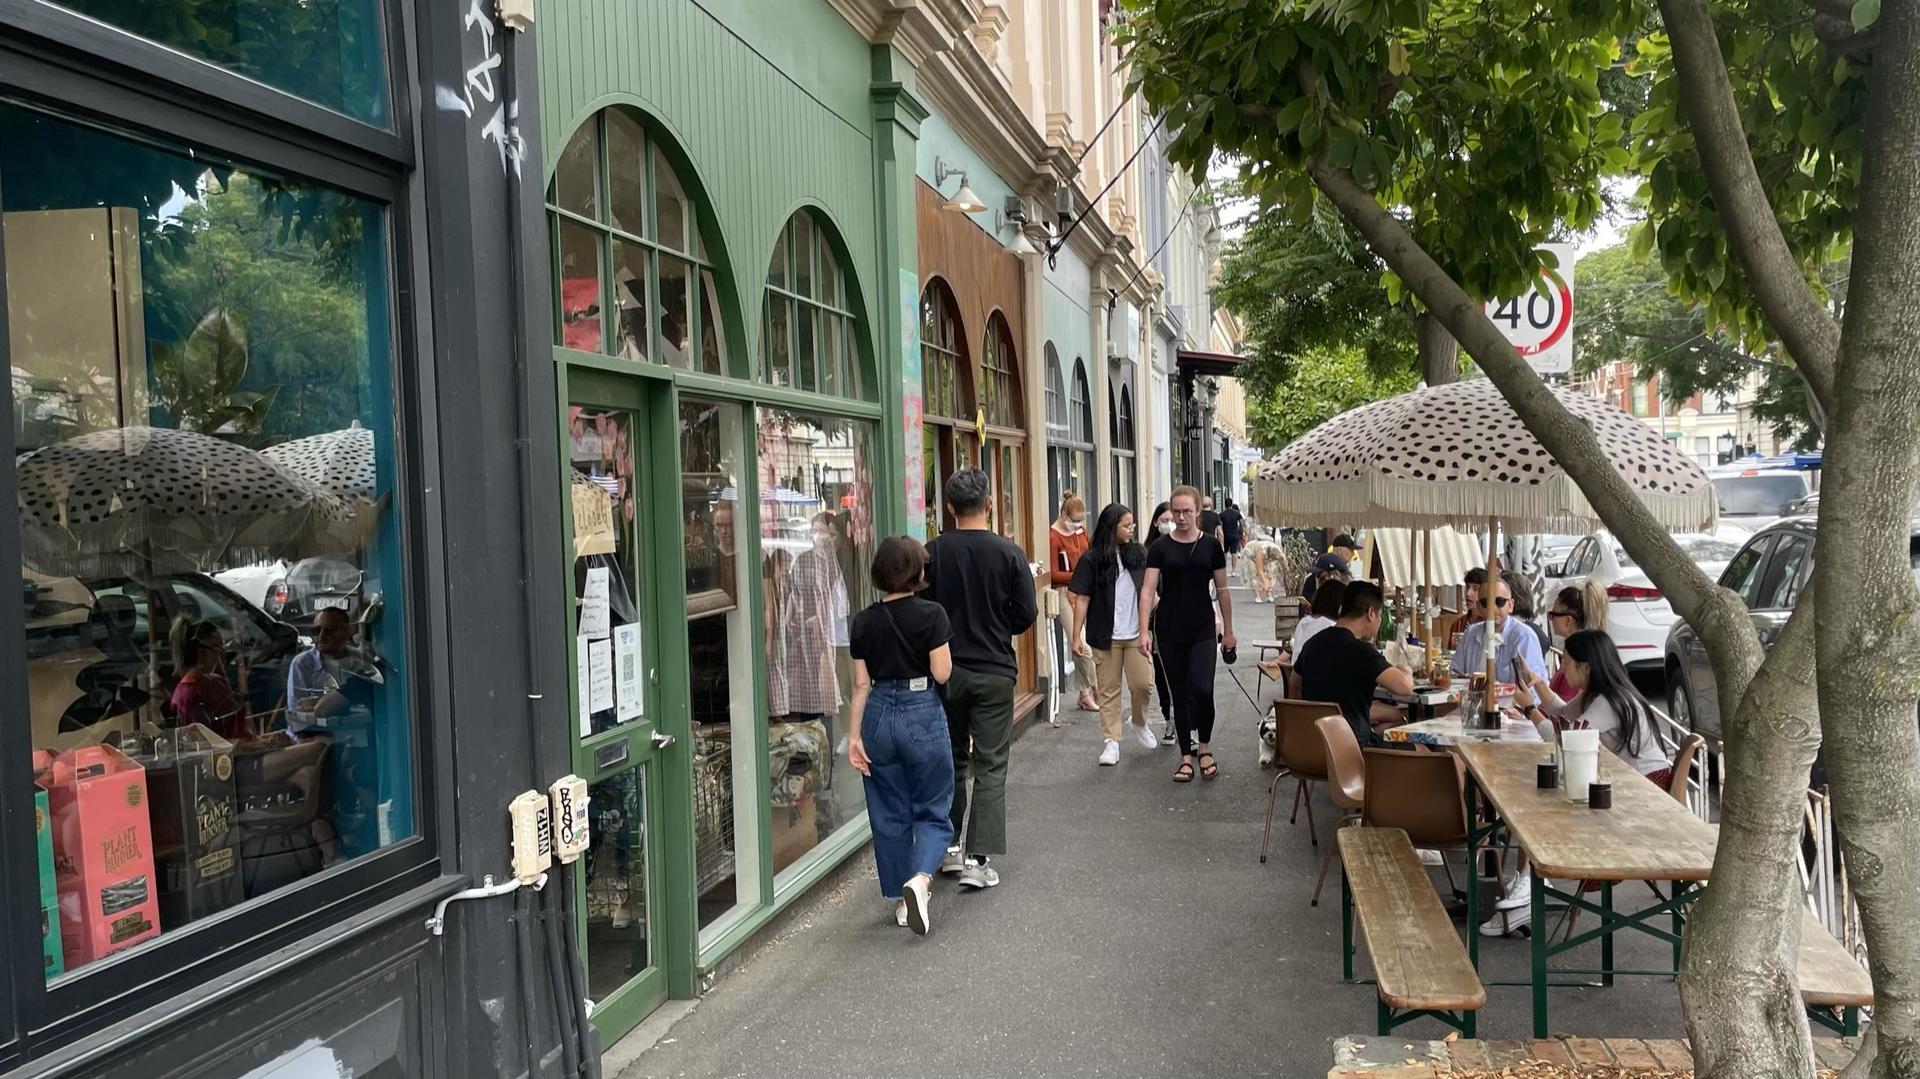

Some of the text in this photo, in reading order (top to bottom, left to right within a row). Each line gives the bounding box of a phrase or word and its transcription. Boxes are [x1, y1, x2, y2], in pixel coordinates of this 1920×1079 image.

[1492, 291, 1555, 329] 40
[101, 825, 136, 860] PLANT
[104, 842, 142, 874] RUNNER
